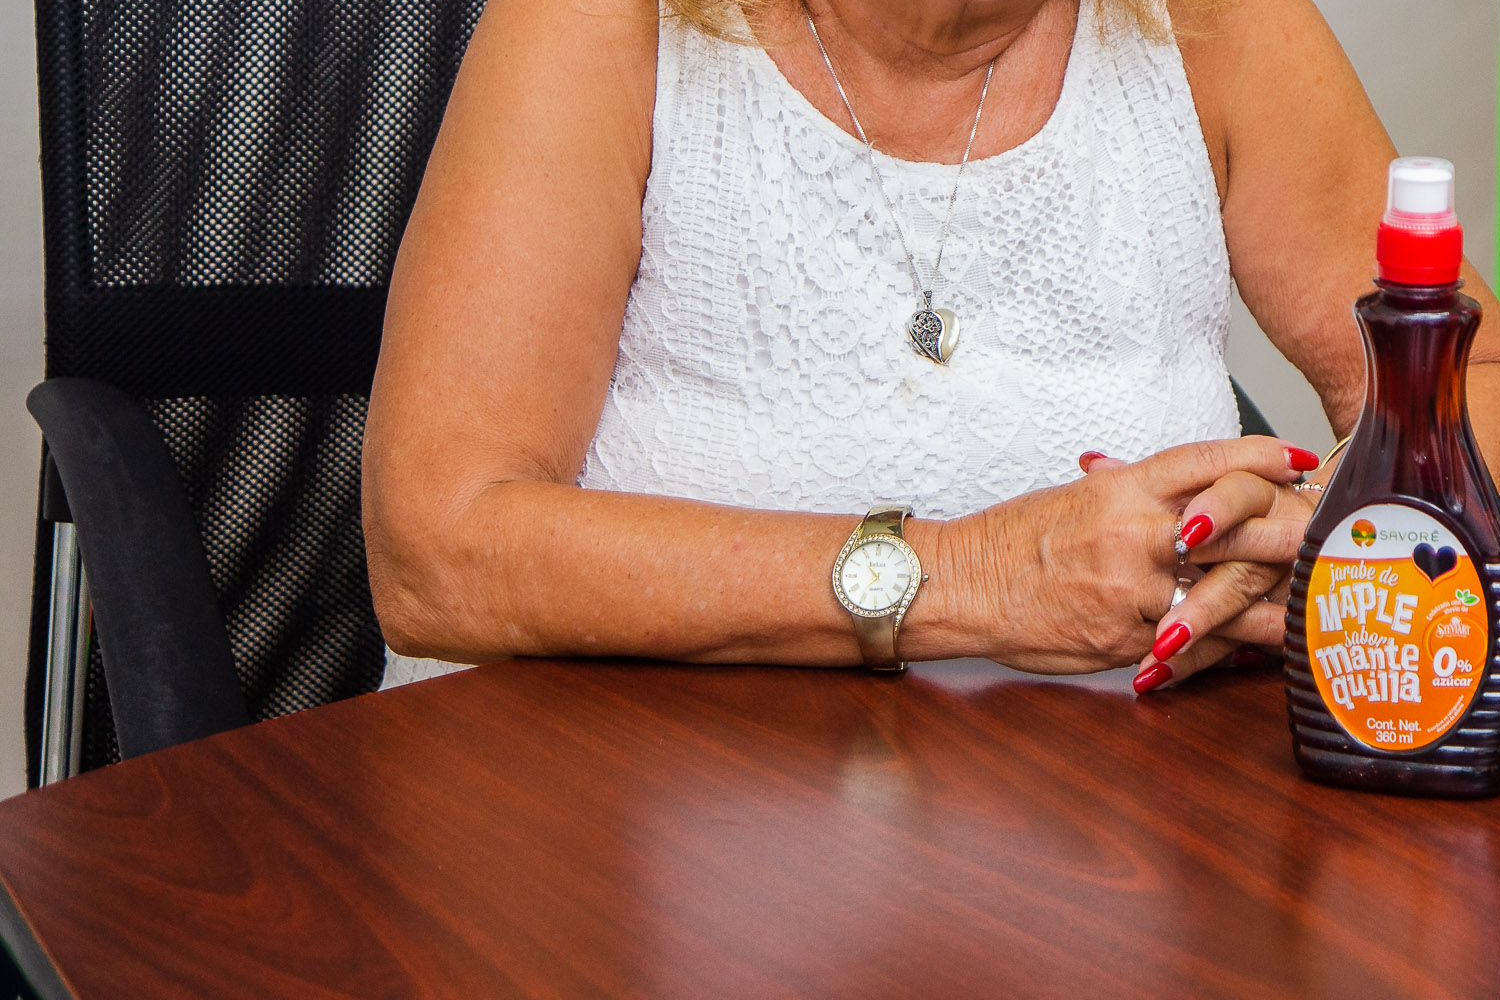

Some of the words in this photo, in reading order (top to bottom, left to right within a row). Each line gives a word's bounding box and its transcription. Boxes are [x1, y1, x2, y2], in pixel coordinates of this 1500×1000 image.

[1329, 560, 1376, 592] jarabe
[1378, 566, 1399, 587] de
[1315, 582, 1419, 635] MAPLE
[1344, 625, 1388, 648] sabor
[1315, 638, 1420, 679] mante
[1432, 646, 1472, 678] 0%
[1331, 670, 1422, 711] quilla
[1431, 676, 1473, 688] azúcar
[1366, 717, 1397, 732] Cont.
[1398, 719, 1422, 733] Net.
[1375, 730, 1397, 743] 360
[1398, 731, 1414, 744] ml
